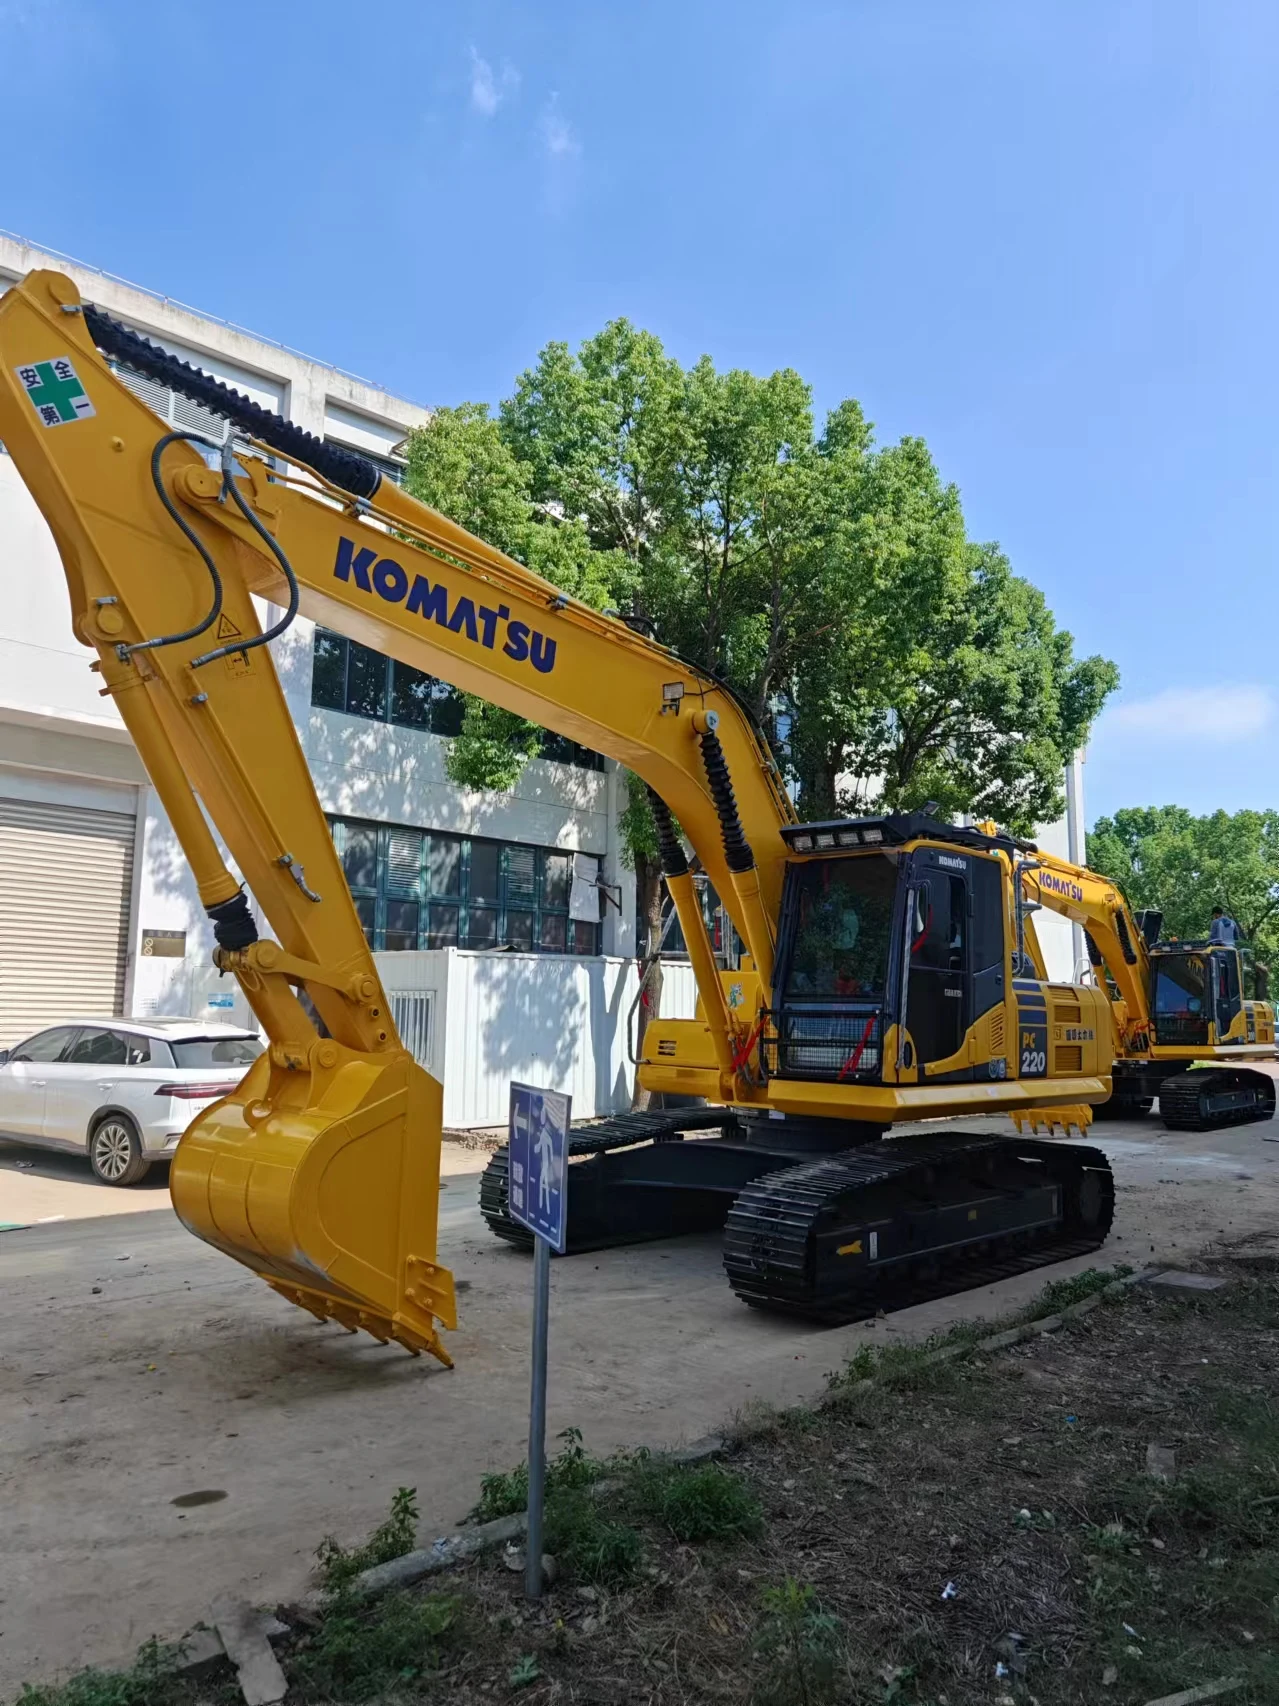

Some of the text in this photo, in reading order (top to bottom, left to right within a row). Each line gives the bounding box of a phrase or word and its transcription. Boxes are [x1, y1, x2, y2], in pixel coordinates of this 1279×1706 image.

[20, 360, 74, 388] 安全
[333, 536, 557, 673] KOMATSU
[938, 855, 967, 870] KOMATSU
[1038, 871, 1083, 902] KOMATSU
[1021, 1051, 1046, 1073] 220
